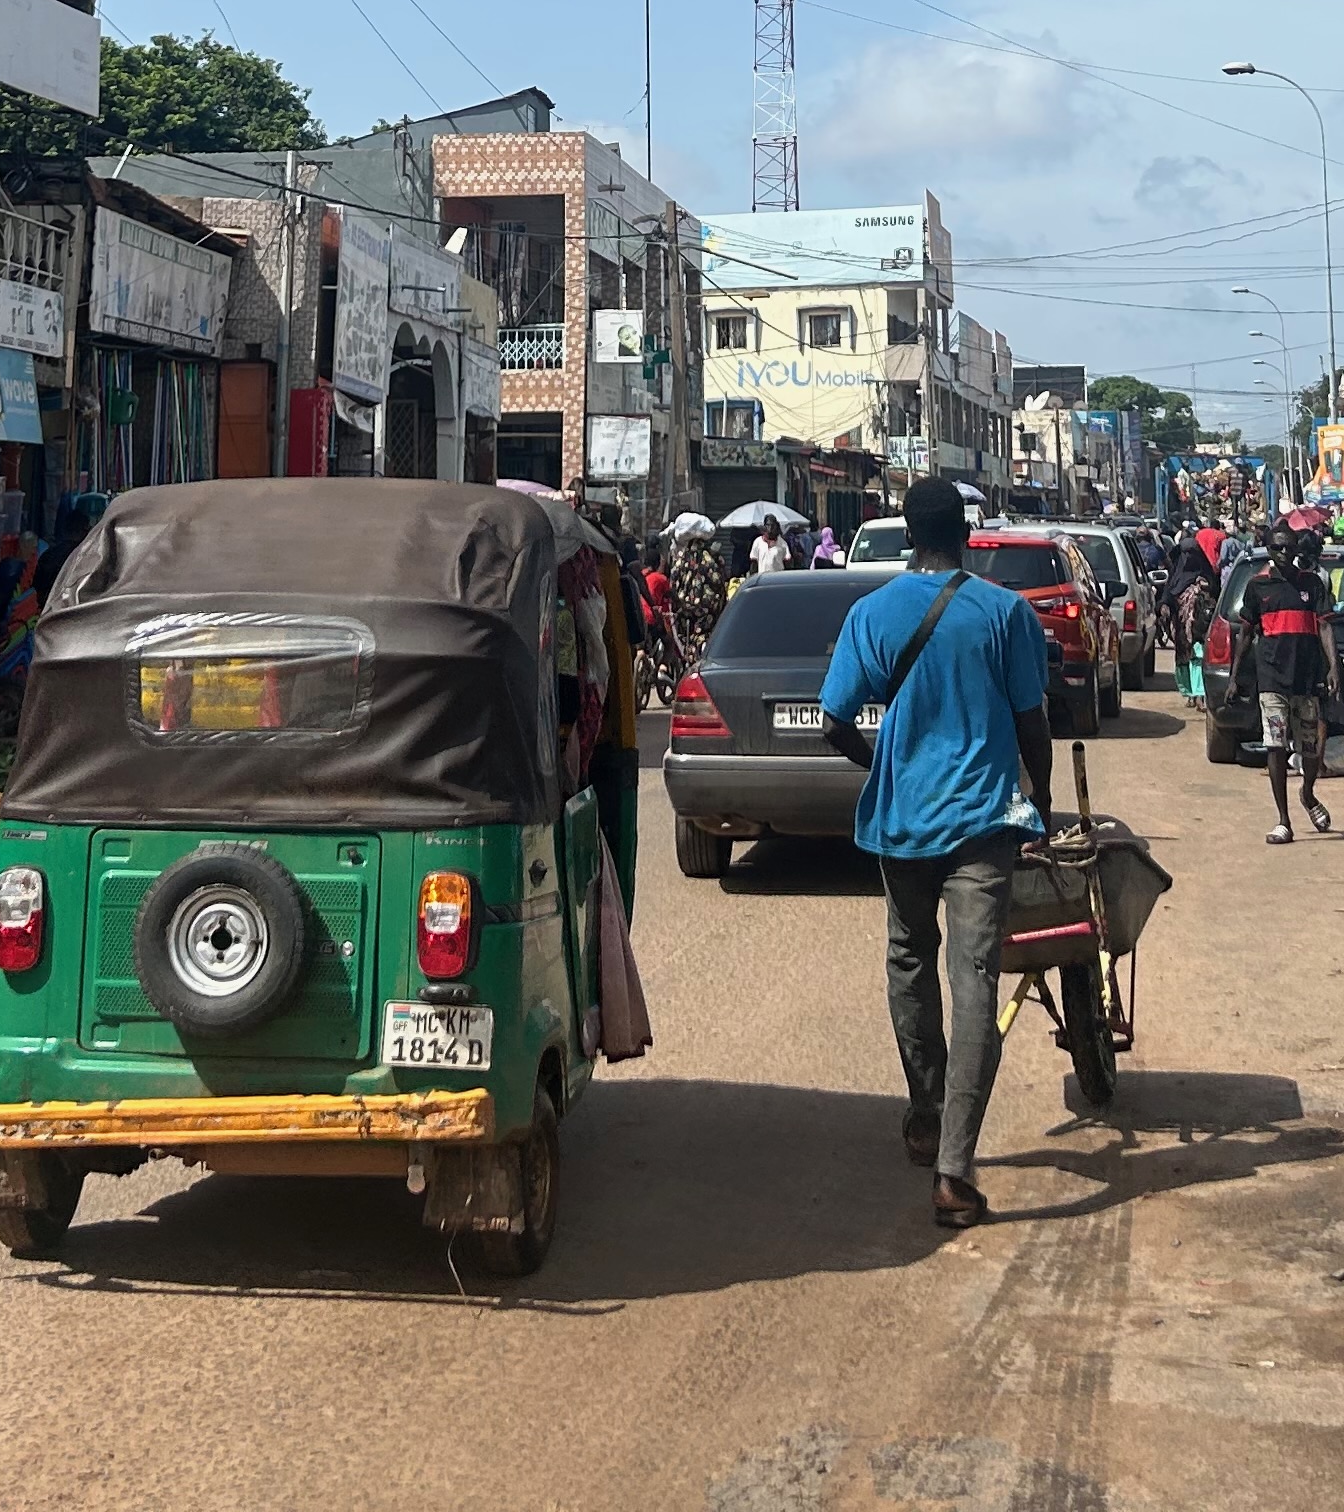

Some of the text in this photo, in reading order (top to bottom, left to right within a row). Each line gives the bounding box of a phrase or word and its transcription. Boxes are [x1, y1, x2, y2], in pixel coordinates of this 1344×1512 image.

[855, 216, 915, 228] SAMSUNG
[2, 378, 35, 404] wave
[416, 1008, 470, 1035] MC KM
[391, 1036, 483, 1065] 1814 D
